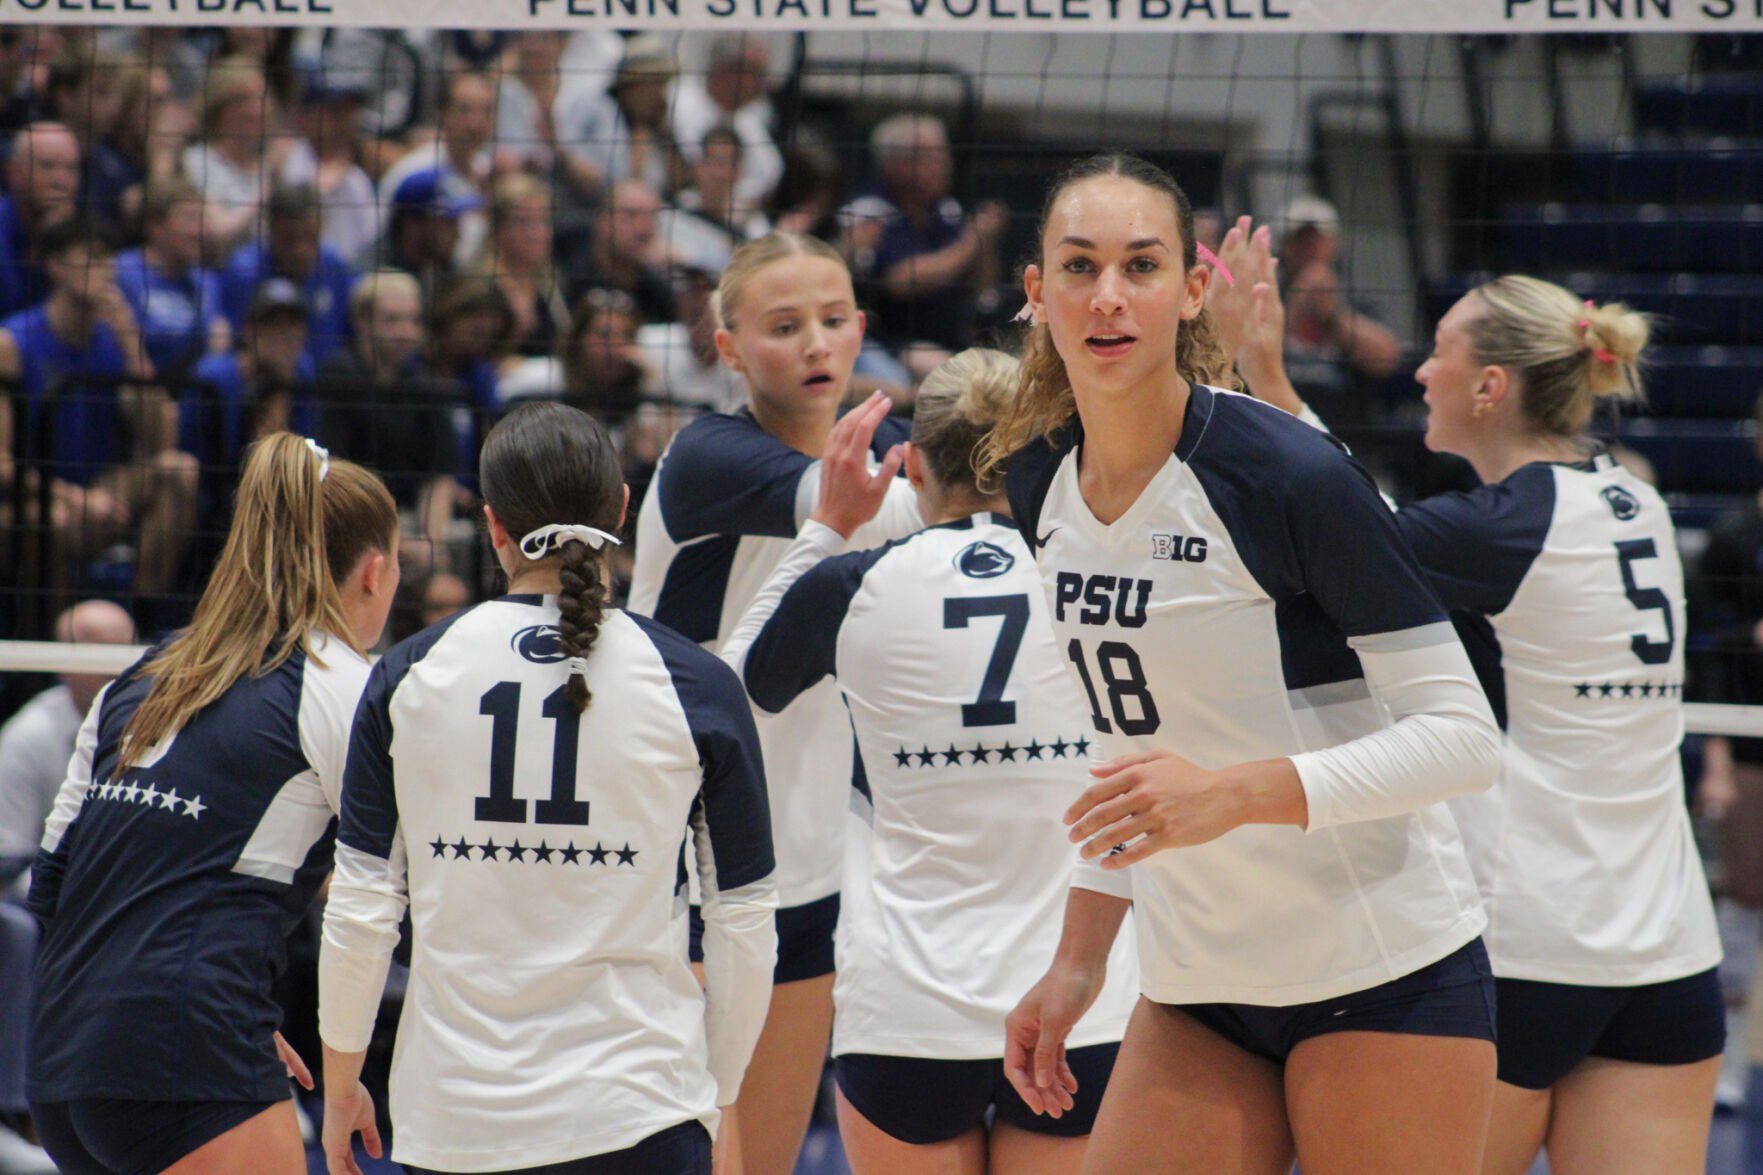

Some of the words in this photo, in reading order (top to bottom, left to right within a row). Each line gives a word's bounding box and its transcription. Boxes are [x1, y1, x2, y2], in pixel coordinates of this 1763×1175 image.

[943, 593, 1031, 728] 7
[1056, 571, 1153, 629] PSU
[1613, 537, 1675, 665] 5
[1067, 638, 1161, 737] 18
[474, 680, 590, 826] 11
